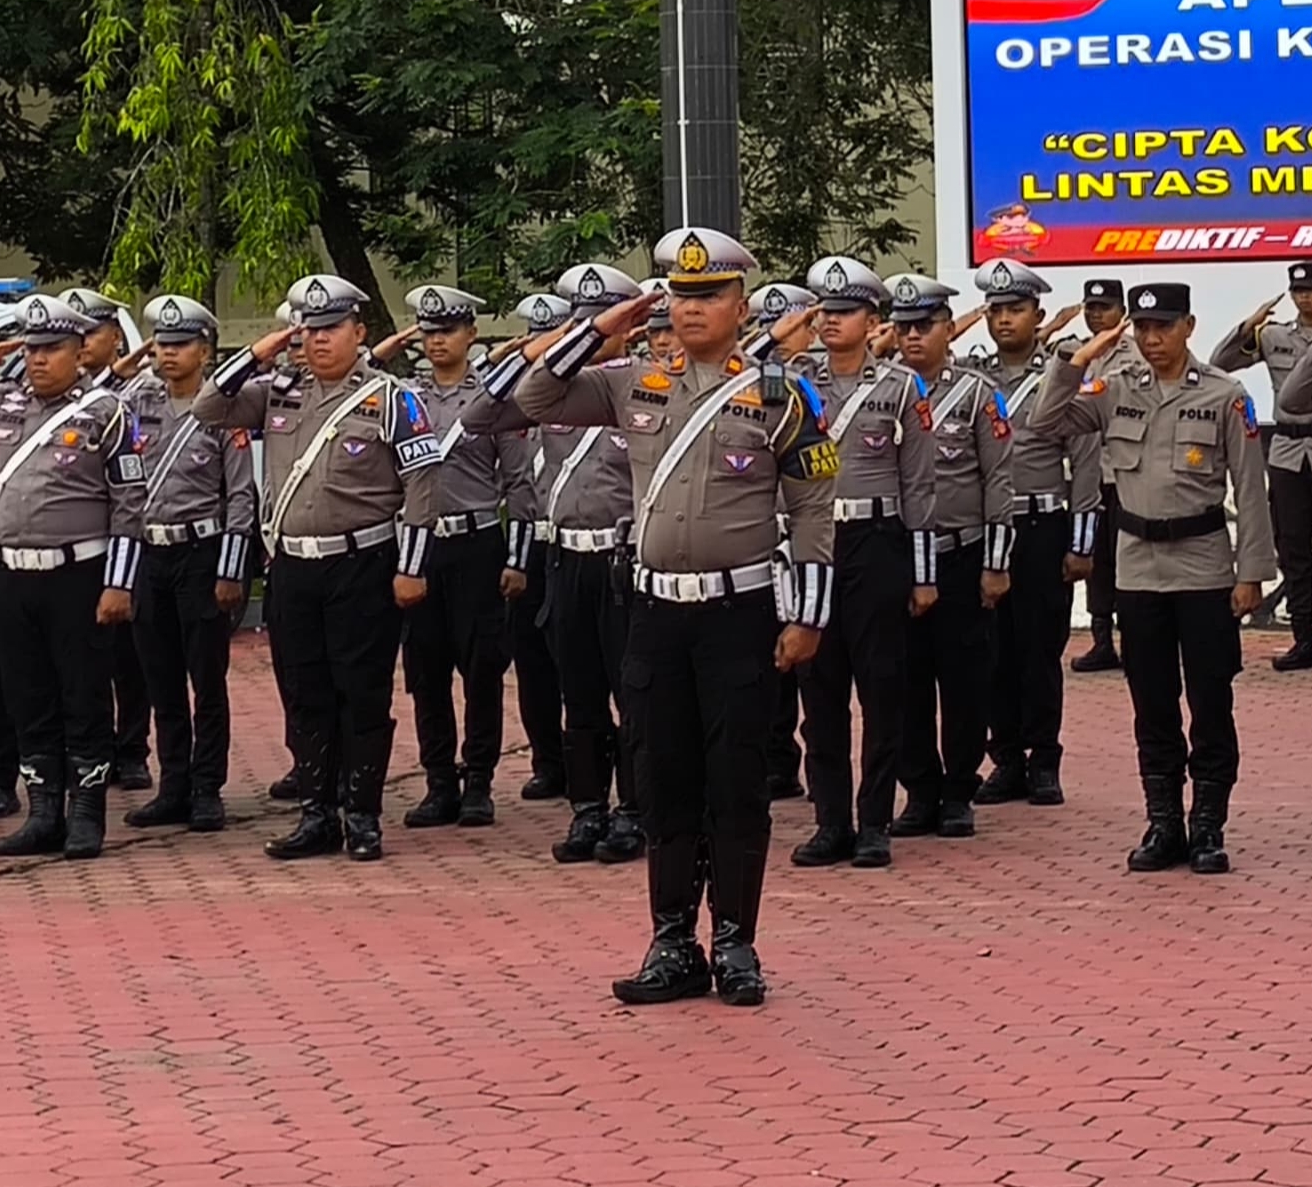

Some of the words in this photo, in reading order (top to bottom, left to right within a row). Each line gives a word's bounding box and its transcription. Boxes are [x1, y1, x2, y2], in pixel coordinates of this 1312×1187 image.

[995, 30, 1253, 69] OPERASI
[1044, 130, 1245, 159] “CIPTA
[1022, 171, 1230, 200] LINTAS
[1093, 227, 1266, 253] PREDIKTIF
[353, 406, 381, 419] OLRI
[721, 403, 768, 424] POLRI
[1115, 405, 1146, 420] EDDY
[1178, 408, 1217, 422] POLRI
